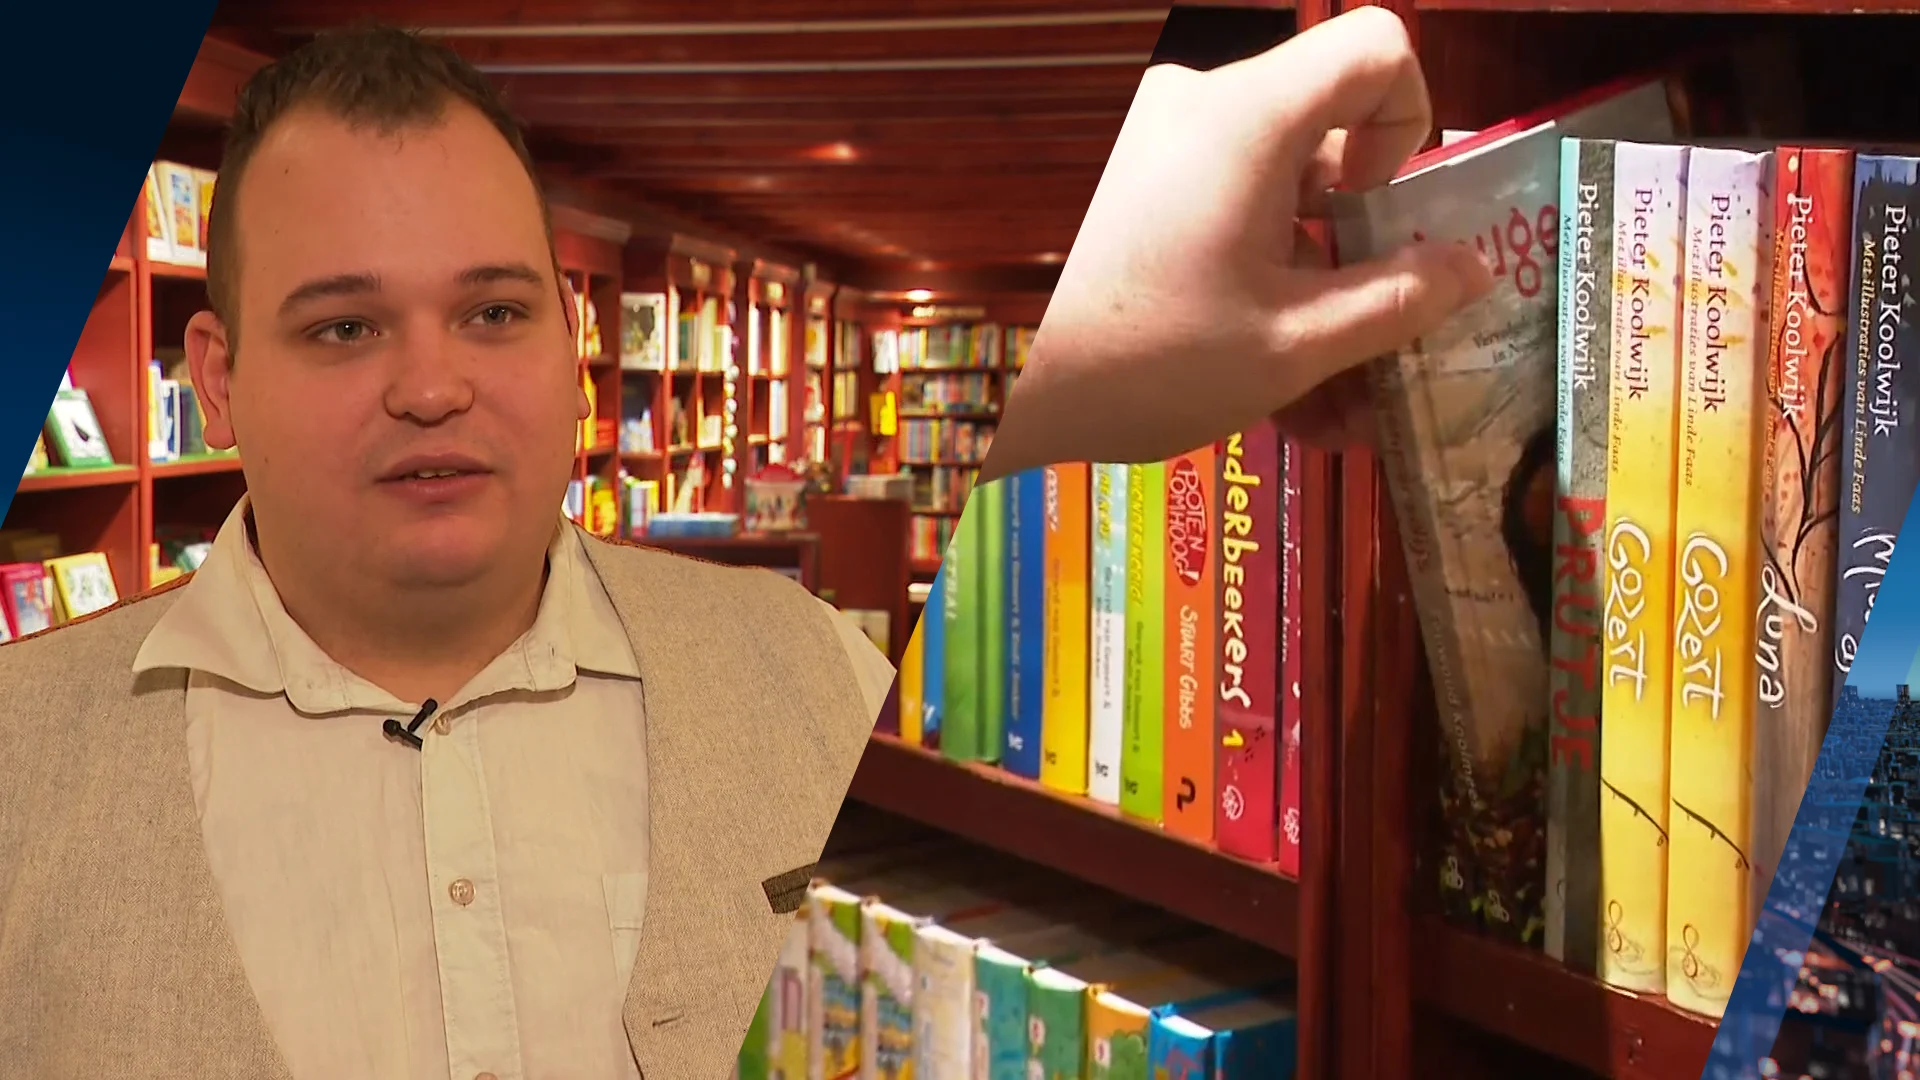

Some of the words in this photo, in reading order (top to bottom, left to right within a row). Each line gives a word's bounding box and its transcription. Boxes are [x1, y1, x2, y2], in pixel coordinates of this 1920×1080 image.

[1577, 182, 1599, 265] Pieter
[1632, 188, 1654, 270] Pieter
[1691, 226, 1703, 260] Met
[1708, 193, 1731, 279] Pieter
[1789, 194, 1813, 283] Pieter
[1862, 238, 1877, 274] Met
[1881, 204, 1907, 294] Pieter
[1573, 270, 1597, 391] Koolwijk
[1614, 255, 1628, 345] illustraties
[1624, 276, 1651, 402] Koolwijk
[1690, 263, 1703, 357] illustraties
[1858, 278, 1875, 376] illustraties
[1688, 360, 1698, 393] van
[1698, 285, 1727, 414] Koolwijk
[1778, 289, 1808, 420] Koolwijk
[1868, 300, 1902, 438] Koolwijk
[1612, 385, 1624, 431] Linde
[1686, 396, 1698, 444] Linde
[1855, 380, 1868, 414] van
[1611, 434, 1622, 475] Faas
[1684, 447, 1696, 487] Faas
[1853, 418, 1869, 468] Linde
[1168, 476, 1199, 581] OMHOOG!
[1176, 468, 1207, 552] POTEN
[1851, 471, 1865, 514] Faas
[1551, 496, 1607, 771] PRUTJE
[1755, 563, 1818, 705] Luna
[1222, 728, 1244, 747] 1
